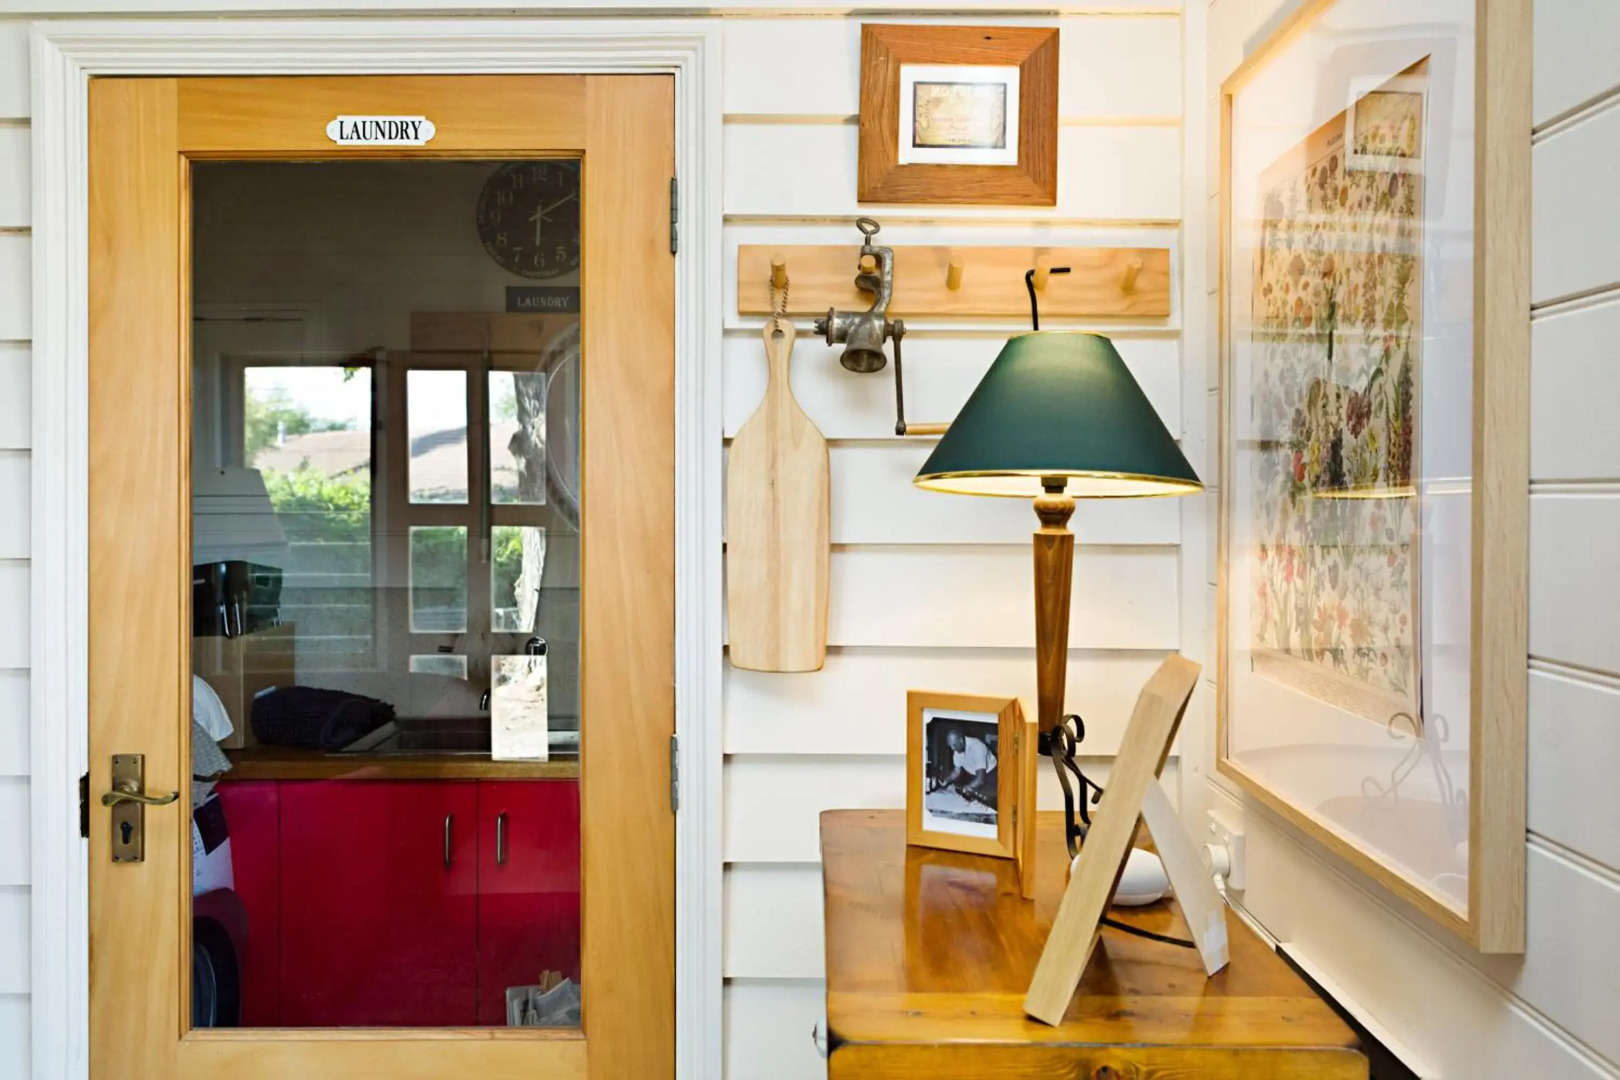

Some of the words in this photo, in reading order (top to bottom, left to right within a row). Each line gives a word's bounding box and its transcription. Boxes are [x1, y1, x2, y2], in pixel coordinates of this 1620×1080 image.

[339, 121, 422, 140] LAUNDRY
[511, 173, 523, 189] 11
[532, 166, 548, 181] 12
[557, 172, 563, 186] 1
[497, 190, 513, 205] 10
[490, 210, 501, 223] 9
[496, 231, 507, 246] 8
[513, 246, 523, 262] 7
[534, 253, 545, 267] 6
[556, 246, 566, 262] 5
[517, 296, 570, 307] LAUNDRY
